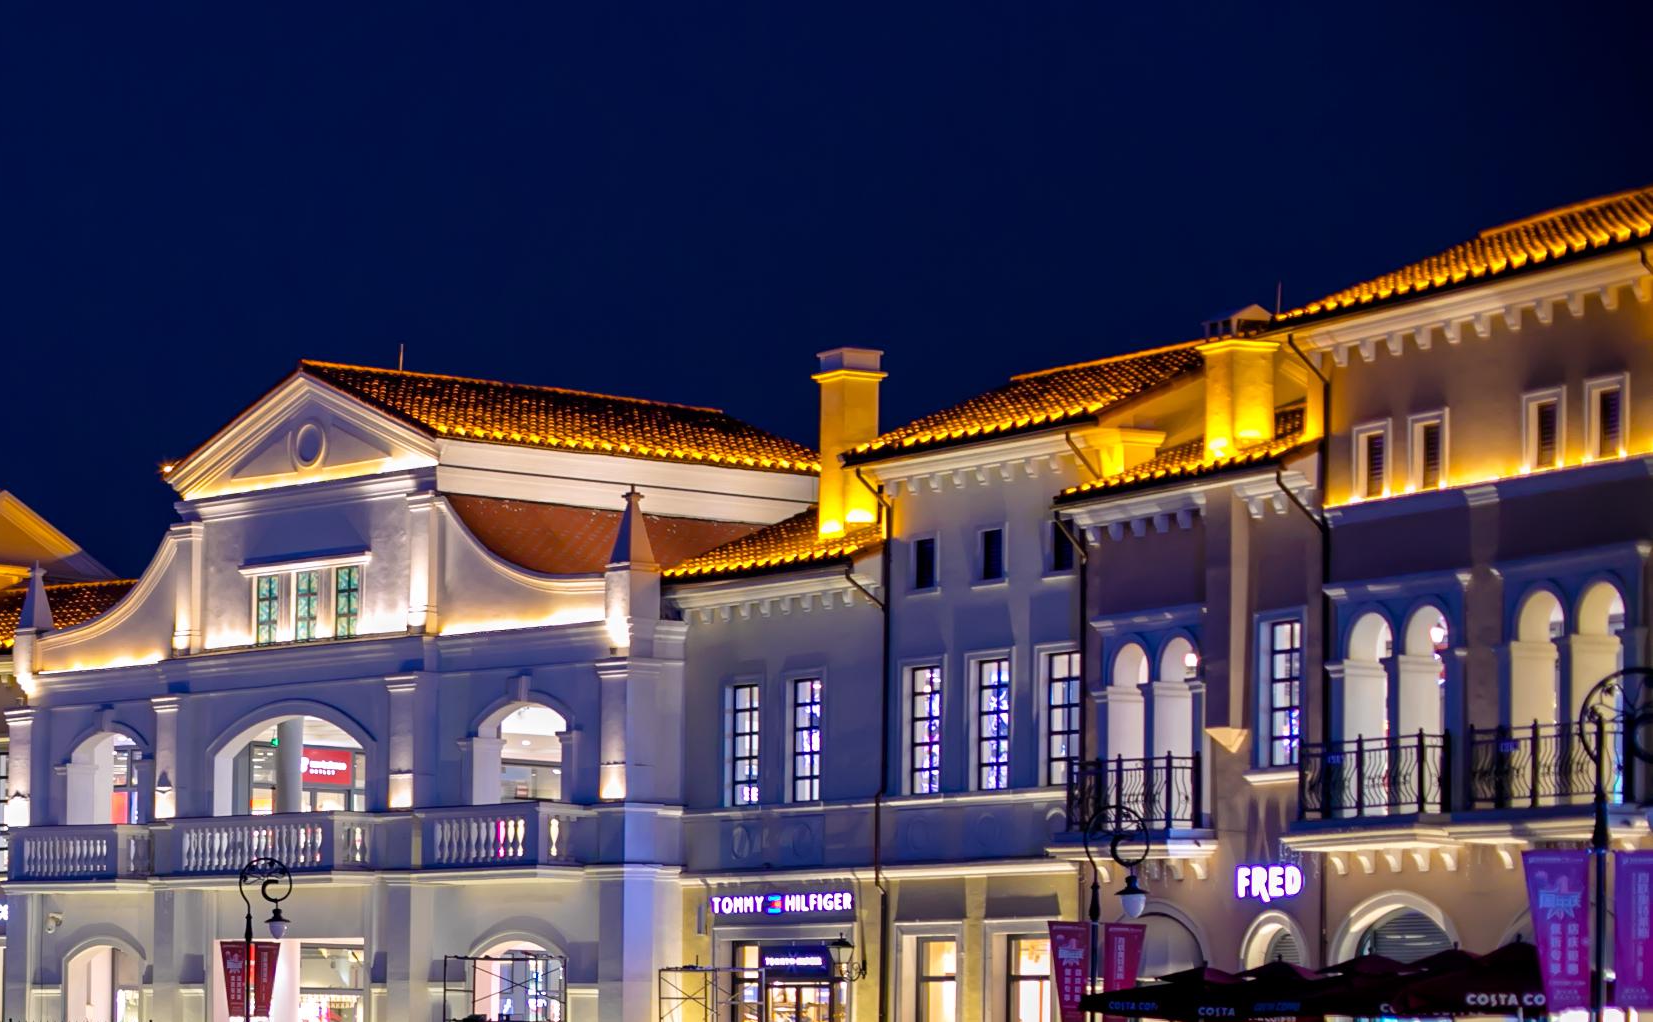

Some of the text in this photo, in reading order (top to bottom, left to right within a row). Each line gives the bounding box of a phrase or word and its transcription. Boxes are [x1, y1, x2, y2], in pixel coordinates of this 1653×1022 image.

[1237, 866, 1302, 903] FRED
[712, 893, 852, 914] TOMMY HILFIGER
[1465, 993, 1519, 1007] COSTA
[1198, 1006, 1236, 1017] COSTA
